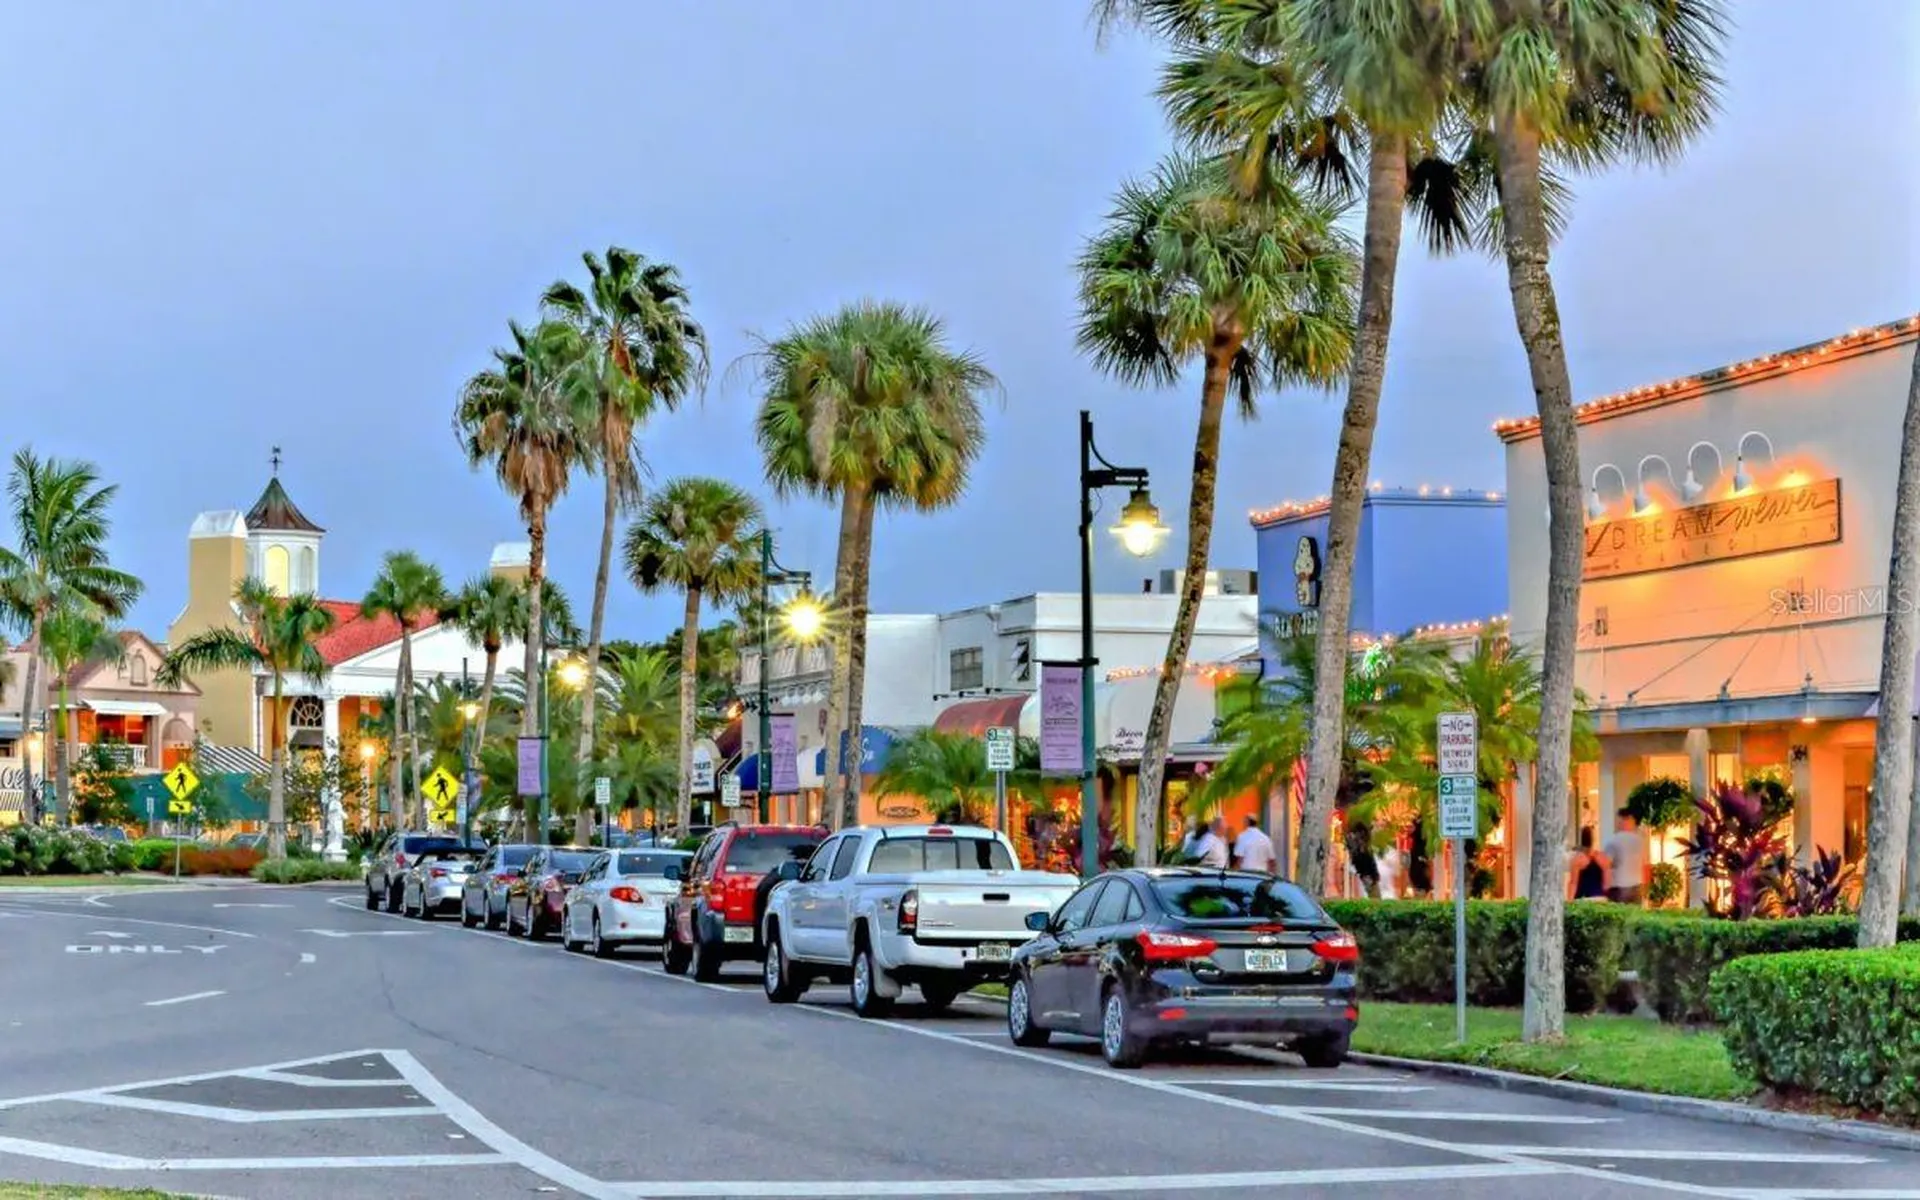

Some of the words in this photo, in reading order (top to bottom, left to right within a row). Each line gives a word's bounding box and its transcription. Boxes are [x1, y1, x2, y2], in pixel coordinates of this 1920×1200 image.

[1611, 508, 1716, 550] DREAM
[1450, 719, 1464, 731] NO
[1442, 779, 1452, 793] 3
[65, 945, 228, 954] ONLY
